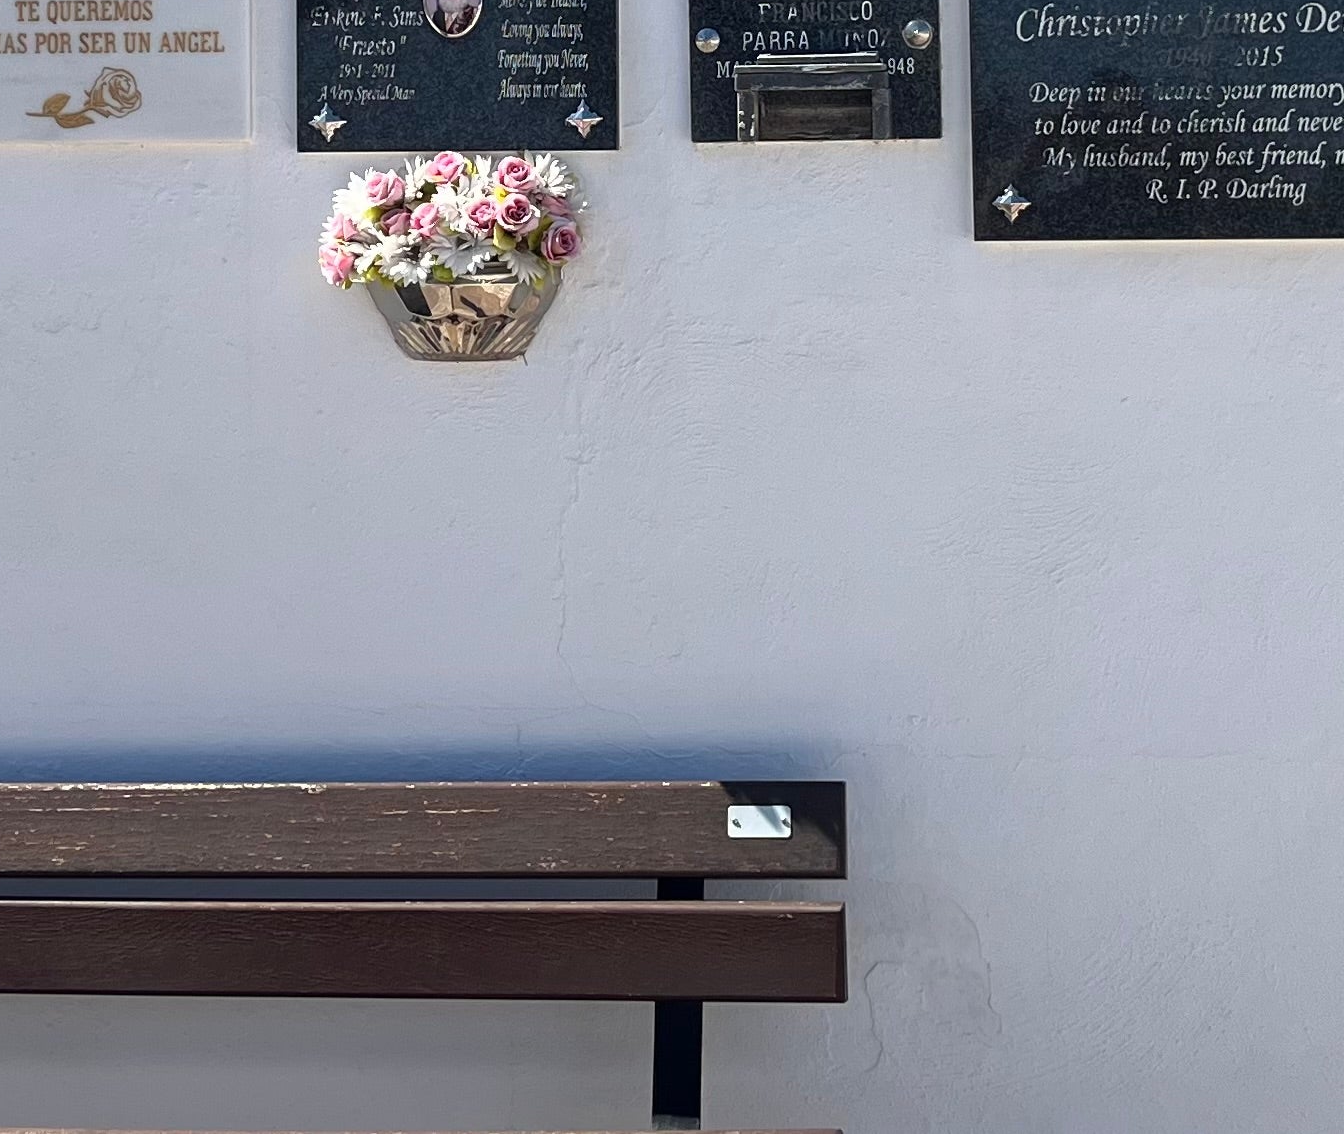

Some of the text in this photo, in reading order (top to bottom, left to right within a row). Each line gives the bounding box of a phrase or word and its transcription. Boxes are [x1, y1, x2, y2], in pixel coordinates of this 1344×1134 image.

[15, 0, 153, 24] TE QUEREMOS
[35, 32, 72, 54] POR
[79, 32, 117, 54] SER
[123, 32, 151, 53] UN
[158, 31, 224, 53] ANGEL
[743, 31, 808, 51] PARRA
[497, 49, 542, 75] Forgetting
[542, 54, 559, 75] you
[879, 58, 915, 75] 948
[1035, 118, 1054, 135] to
[1061, 112, 1100, 134] love
[1106, 111, 1145, 134] and
[1177, 110, 1246, 134] cherish
[1252, 112, 1292, 133] and
[1042, 147, 1076, 175] My
[1084, 144, 1171, 170] husband,
[1180, 151, 1208, 173] my
[1215, 143, 1254, 165] best
[1256, 142, 1327, 173] friend,
[1146, 177, 1306, 206] R. I. P. Darling
